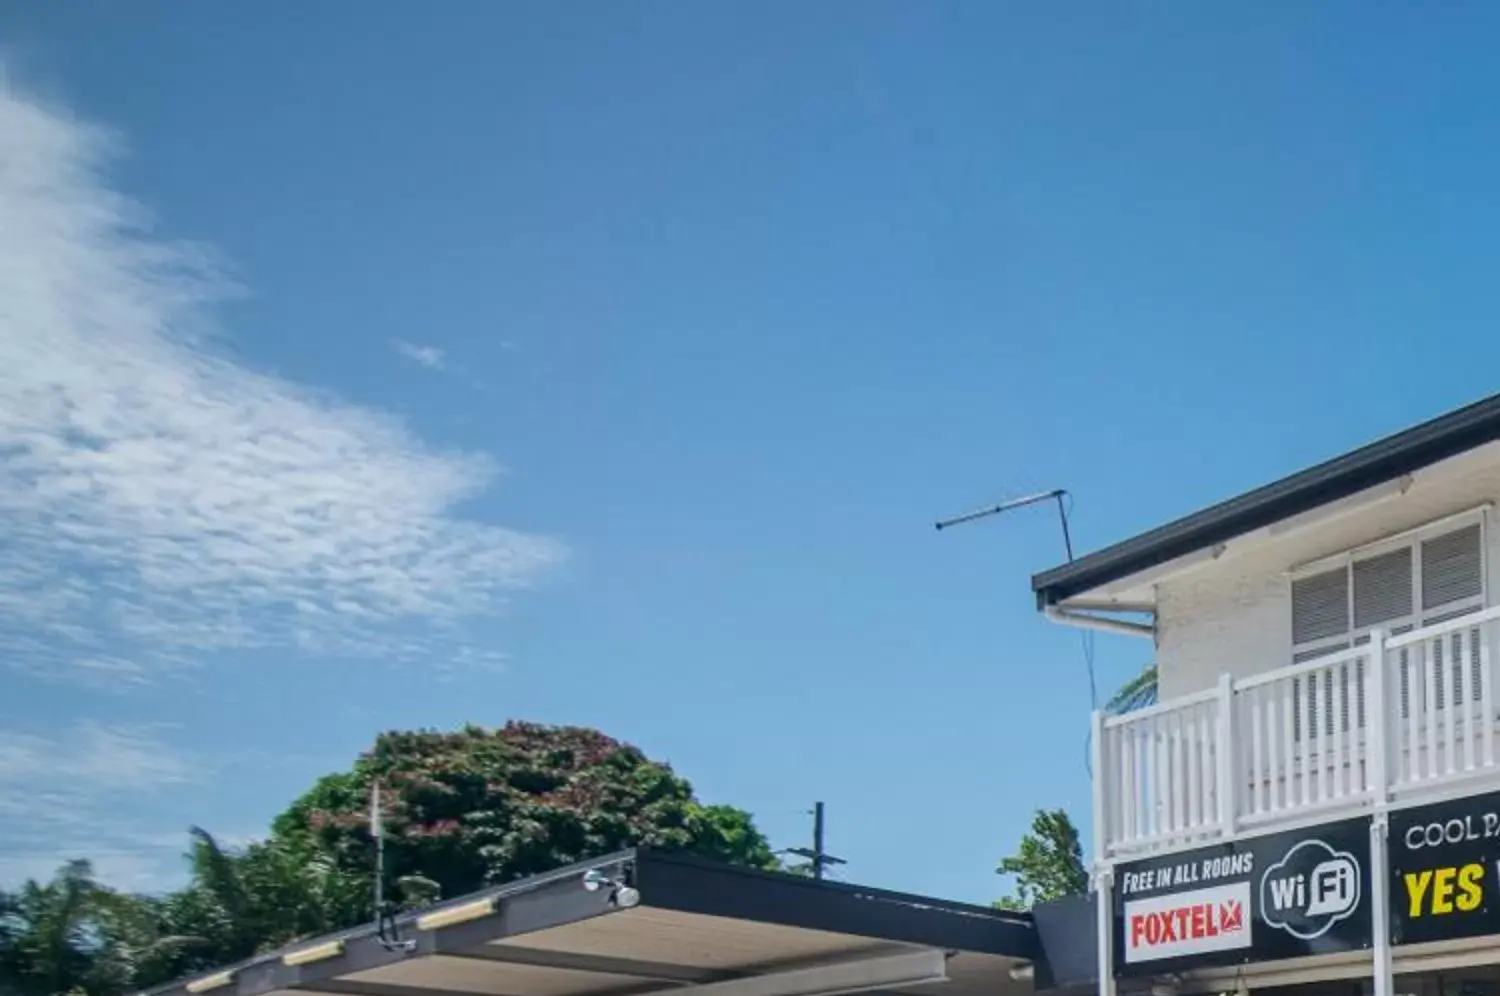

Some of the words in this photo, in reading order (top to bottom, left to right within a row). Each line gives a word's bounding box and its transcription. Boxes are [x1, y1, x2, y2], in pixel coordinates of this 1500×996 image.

[1404, 816, 1480, 850] COOL
[1122, 868, 1154, 895] FREE
[1156, 864, 1173, 888] IN
[1173, 862, 1199, 884] ALL
[1201, 852, 1254, 880] ROOMS
[1403, 862, 1486, 918] YES
[1131, 902, 1219, 949] FOXTEL
